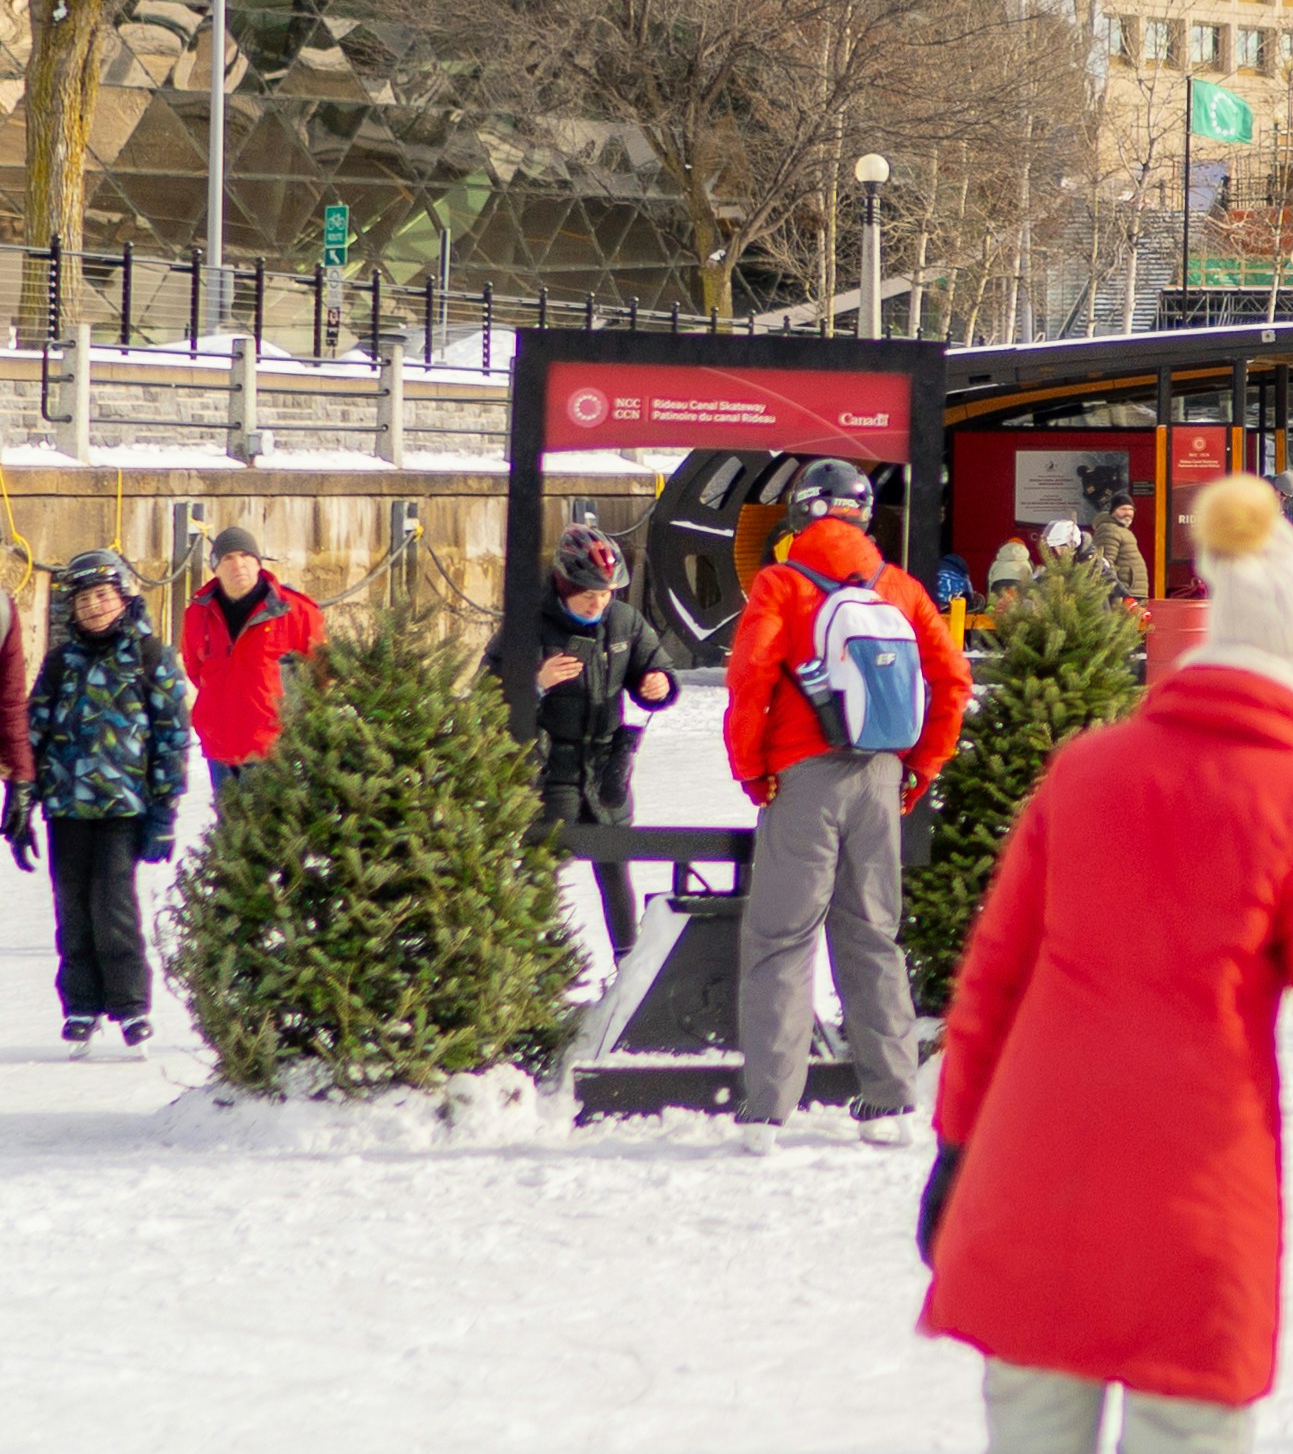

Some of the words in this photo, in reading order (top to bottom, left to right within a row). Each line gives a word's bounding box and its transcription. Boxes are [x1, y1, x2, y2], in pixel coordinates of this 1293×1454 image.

[614, 398, 641, 408] NCC
[653, 399, 688, 409] Rideau
[689, 400, 718, 411] Canal
[719, 401, 766, 414] Skateway
[613, 409, 640, 420] CCN
[652, 410, 698, 421] Patinoire
[699, 411, 712, 422] du
[714, 412, 740, 422] canal
[741, 413, 776, 424] Rideau
[838, 412, 889, 427] Canada
